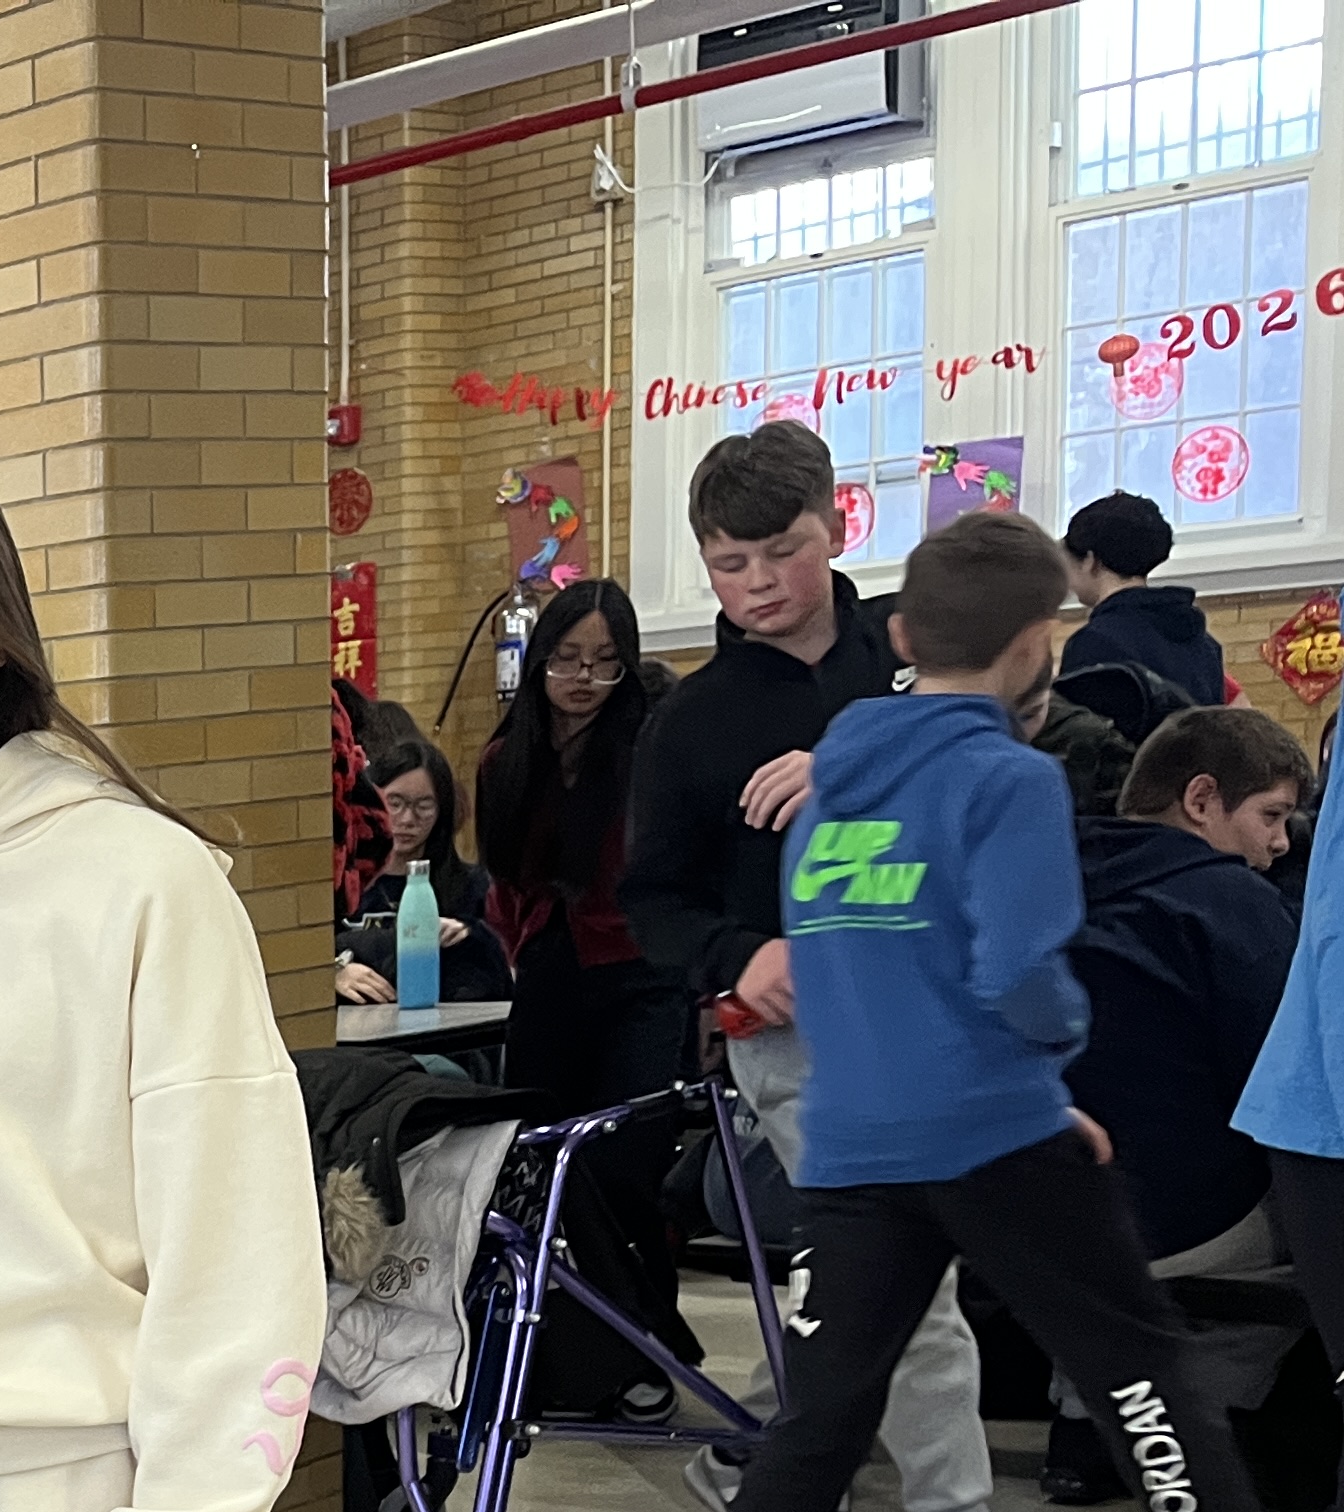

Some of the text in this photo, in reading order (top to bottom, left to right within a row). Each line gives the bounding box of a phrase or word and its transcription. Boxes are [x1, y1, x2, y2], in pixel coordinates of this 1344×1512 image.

[811, 366, 903, 410] New
[935, 342, 1047, 402] year
[1159, 267, 1344, 363] 2026
